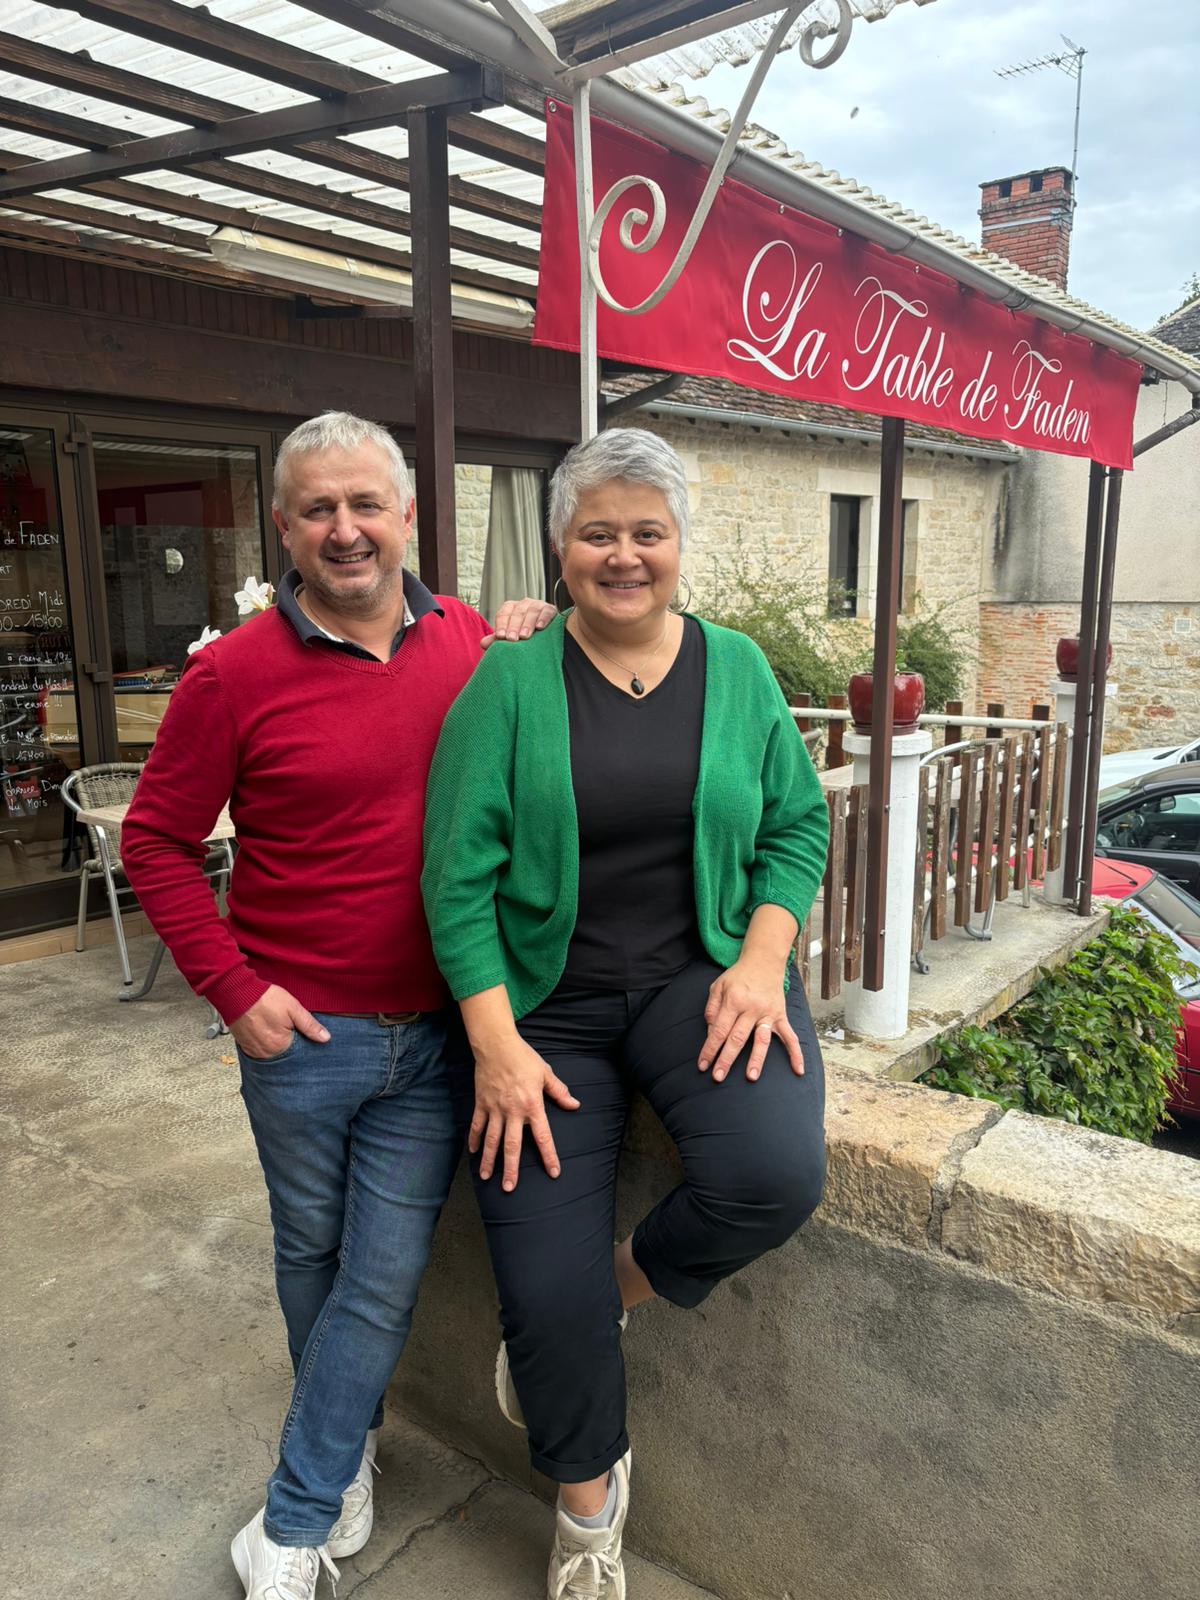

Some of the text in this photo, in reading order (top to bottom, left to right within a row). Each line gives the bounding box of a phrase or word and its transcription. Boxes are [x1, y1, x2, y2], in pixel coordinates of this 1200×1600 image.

[727, 240, 1091, 445] La Table de Faden
[4, 520, 60, 546] de FADEN
[38, 590, 64, 615] Midi
